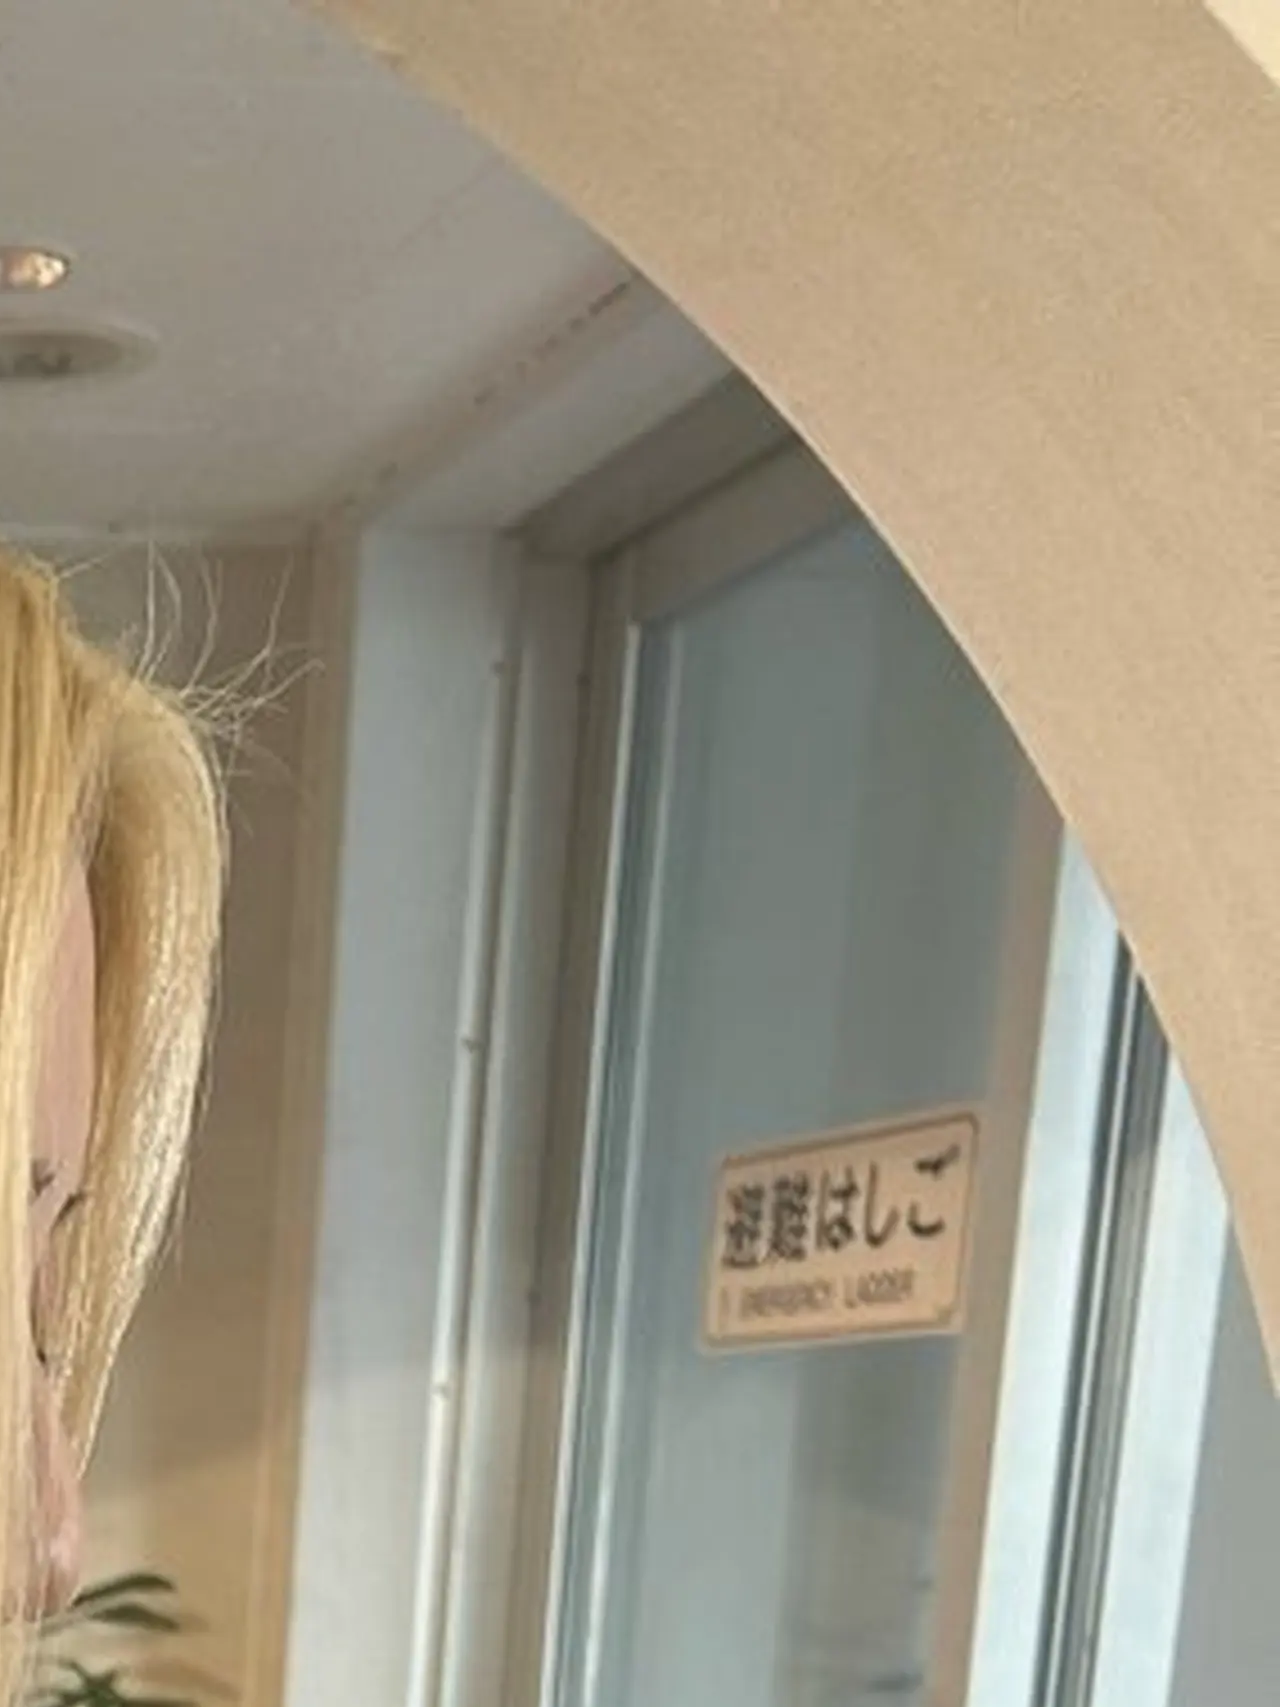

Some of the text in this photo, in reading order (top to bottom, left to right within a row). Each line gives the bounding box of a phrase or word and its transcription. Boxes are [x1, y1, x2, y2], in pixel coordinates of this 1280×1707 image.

[722, 1144, 962, 1268] 避難はしご
